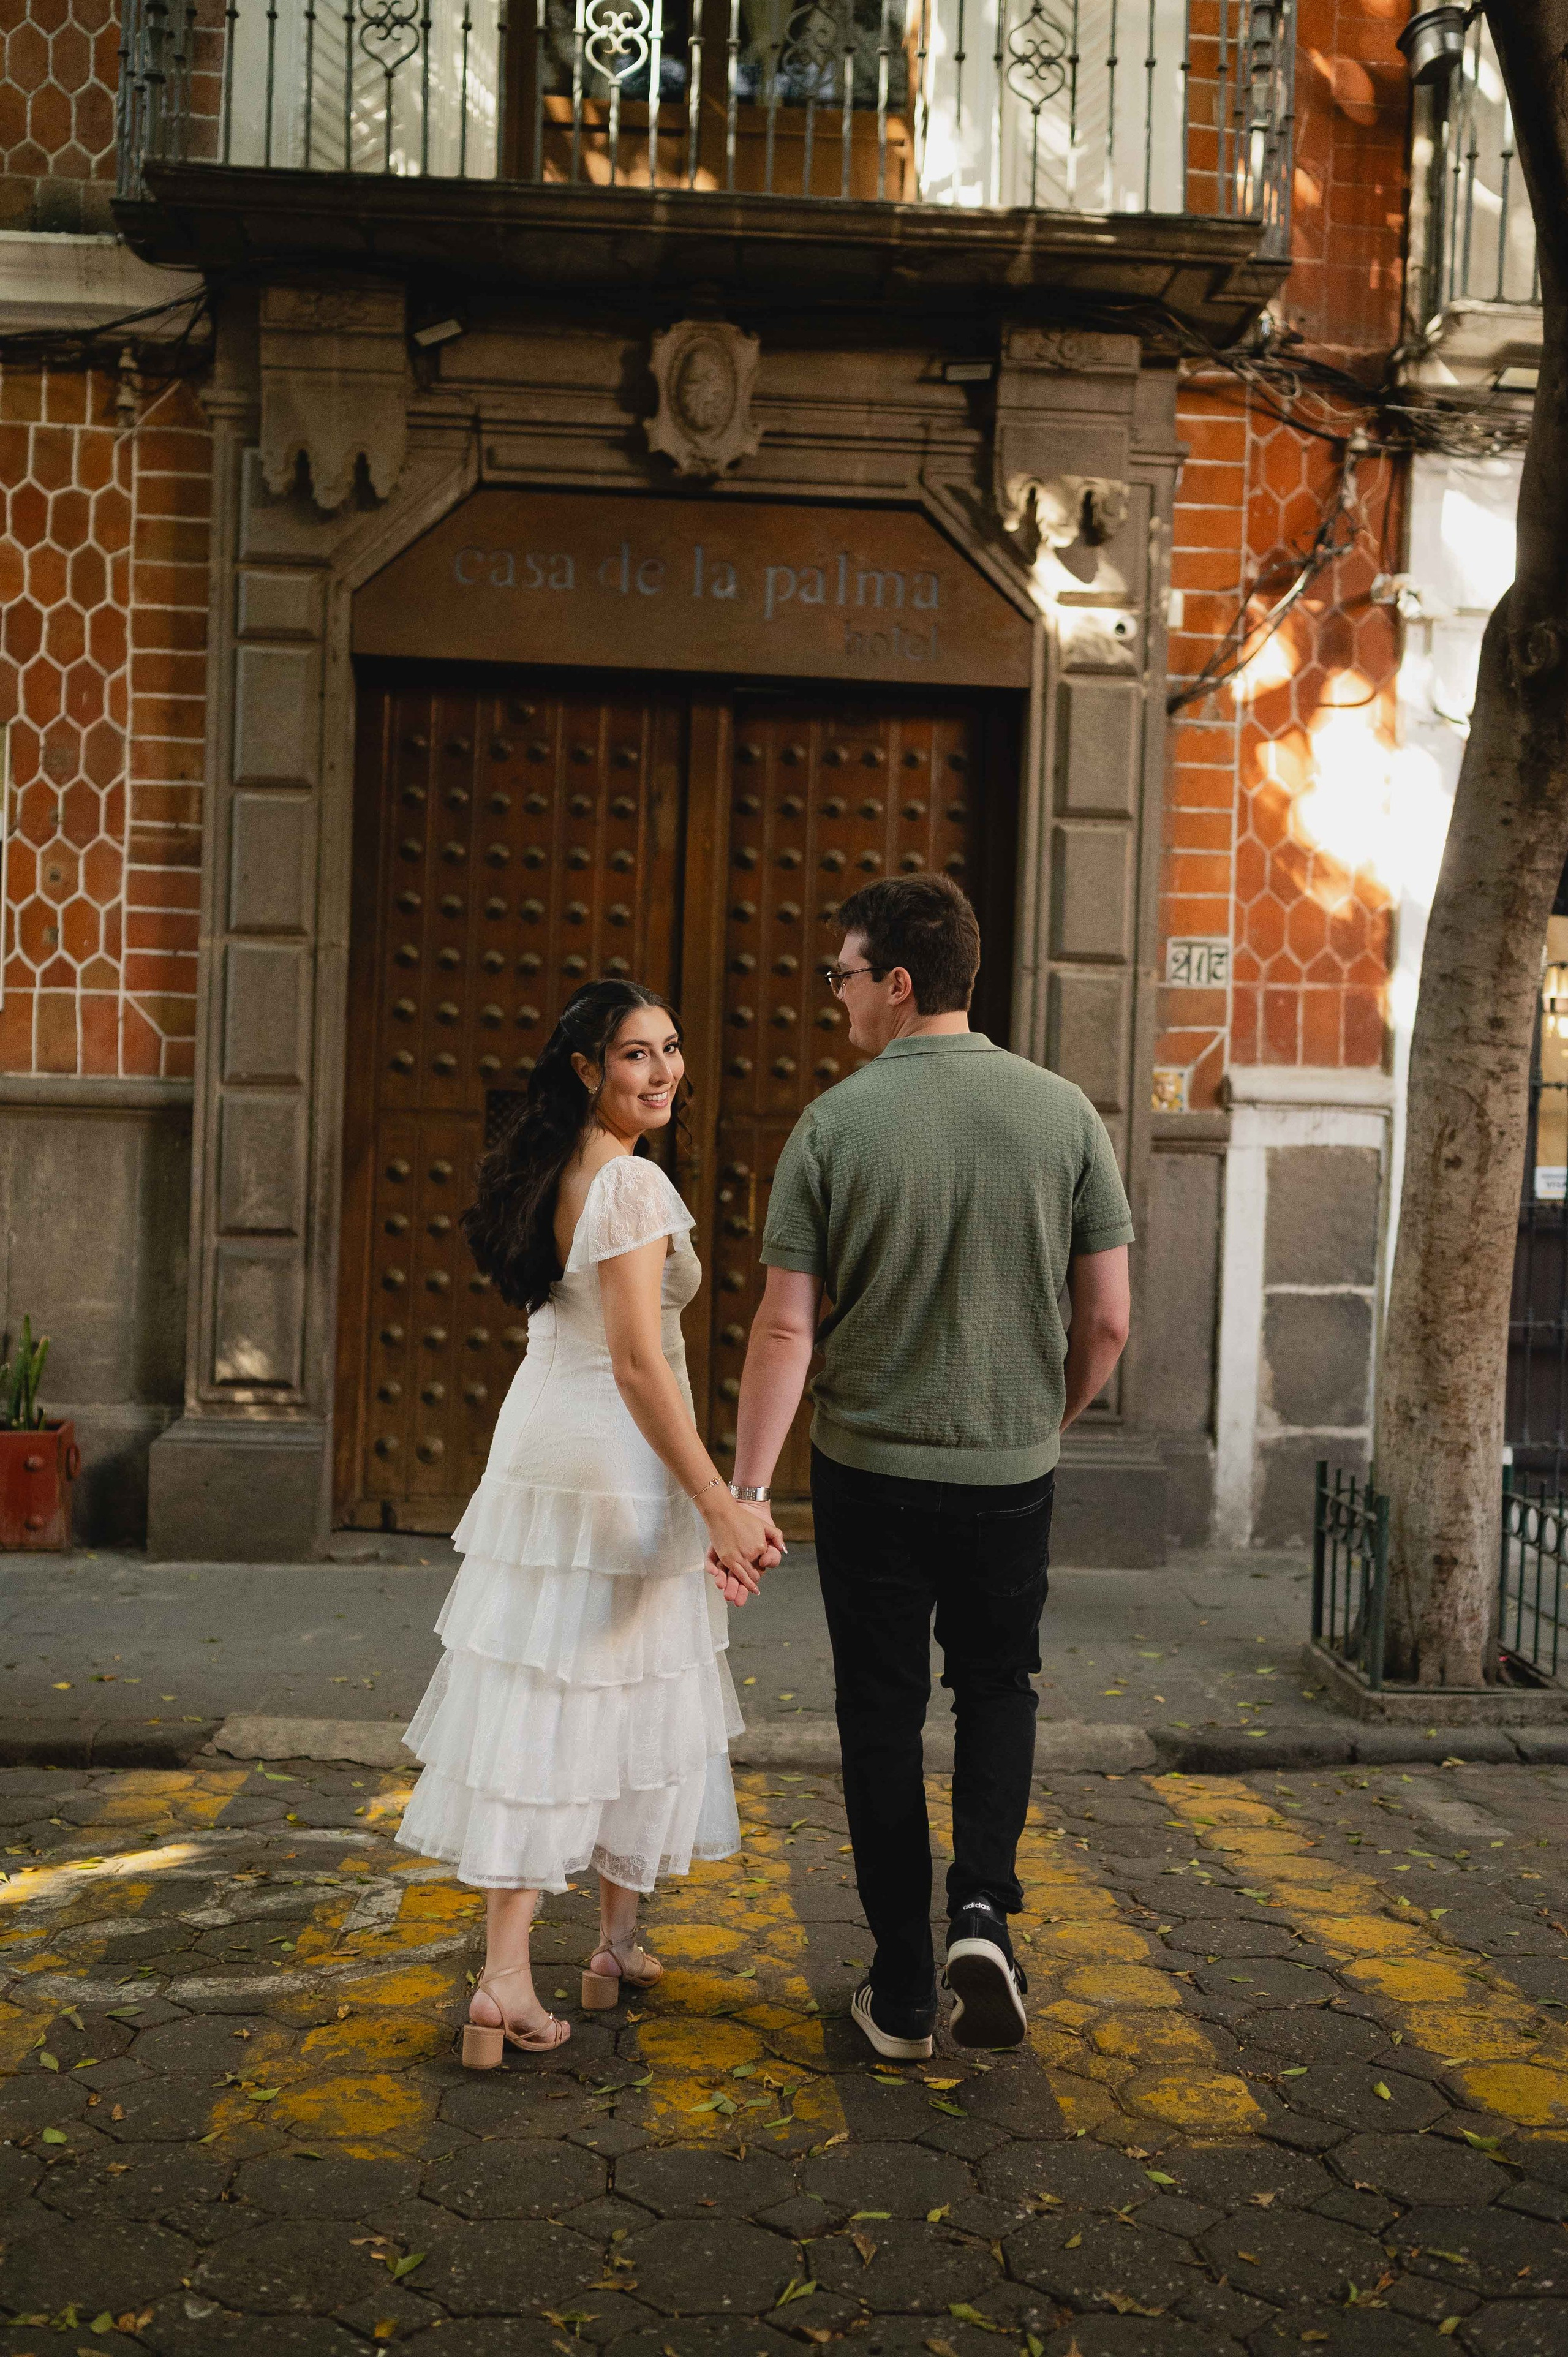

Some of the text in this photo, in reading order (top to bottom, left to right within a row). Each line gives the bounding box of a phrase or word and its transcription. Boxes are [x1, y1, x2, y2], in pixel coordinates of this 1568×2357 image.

[453, 541, 940, 620] casa de la palma
[844, 619, 940, 662] hotel
[963, 1902, 990, 1911] adidas
